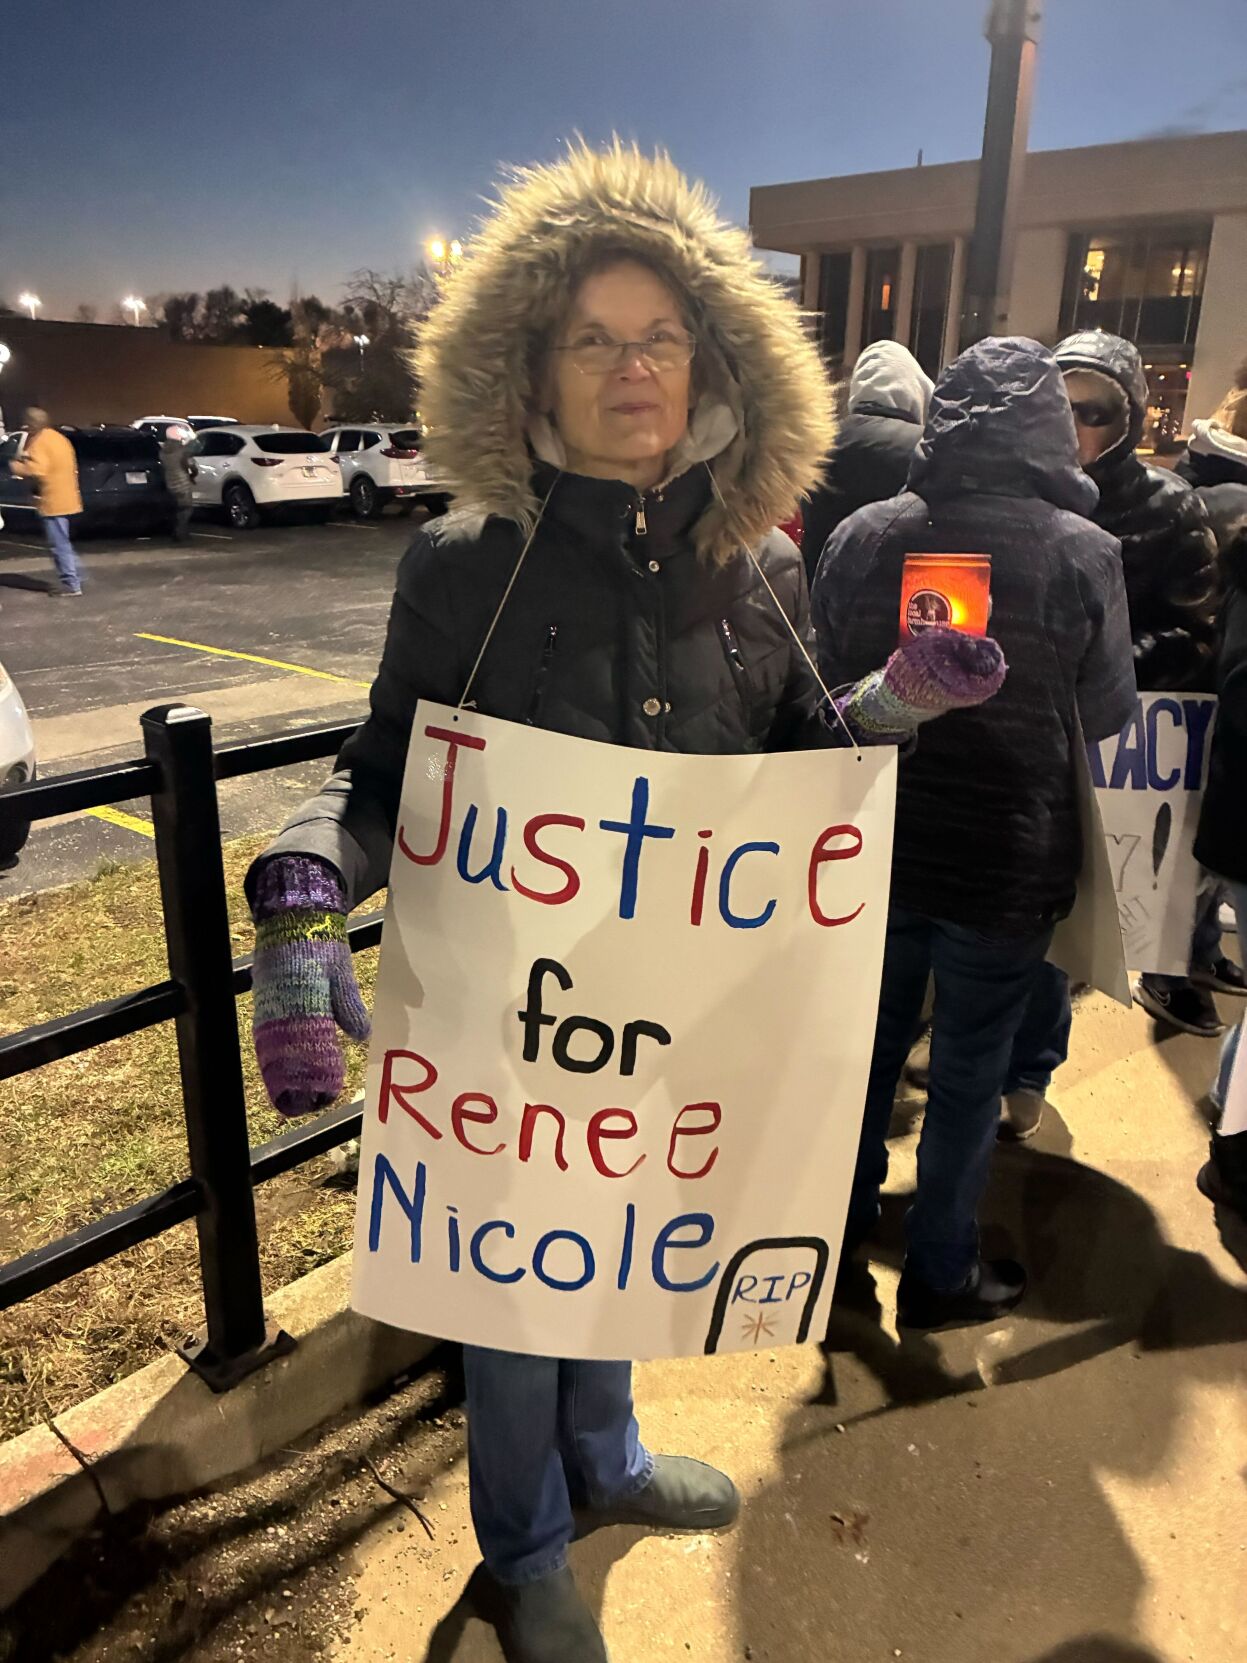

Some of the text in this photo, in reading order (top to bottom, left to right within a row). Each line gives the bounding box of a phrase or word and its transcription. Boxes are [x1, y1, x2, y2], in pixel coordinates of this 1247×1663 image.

[1088, 696, 1216, 791] ACY
[398, 725, 867, 930] Justice
[517, 958, 672, 1076] for
[378, 1046, 722, 1180] Renee
[369, 1153, 722, 1293] Nicole
[731, 1272, 811, 1305] RIP
